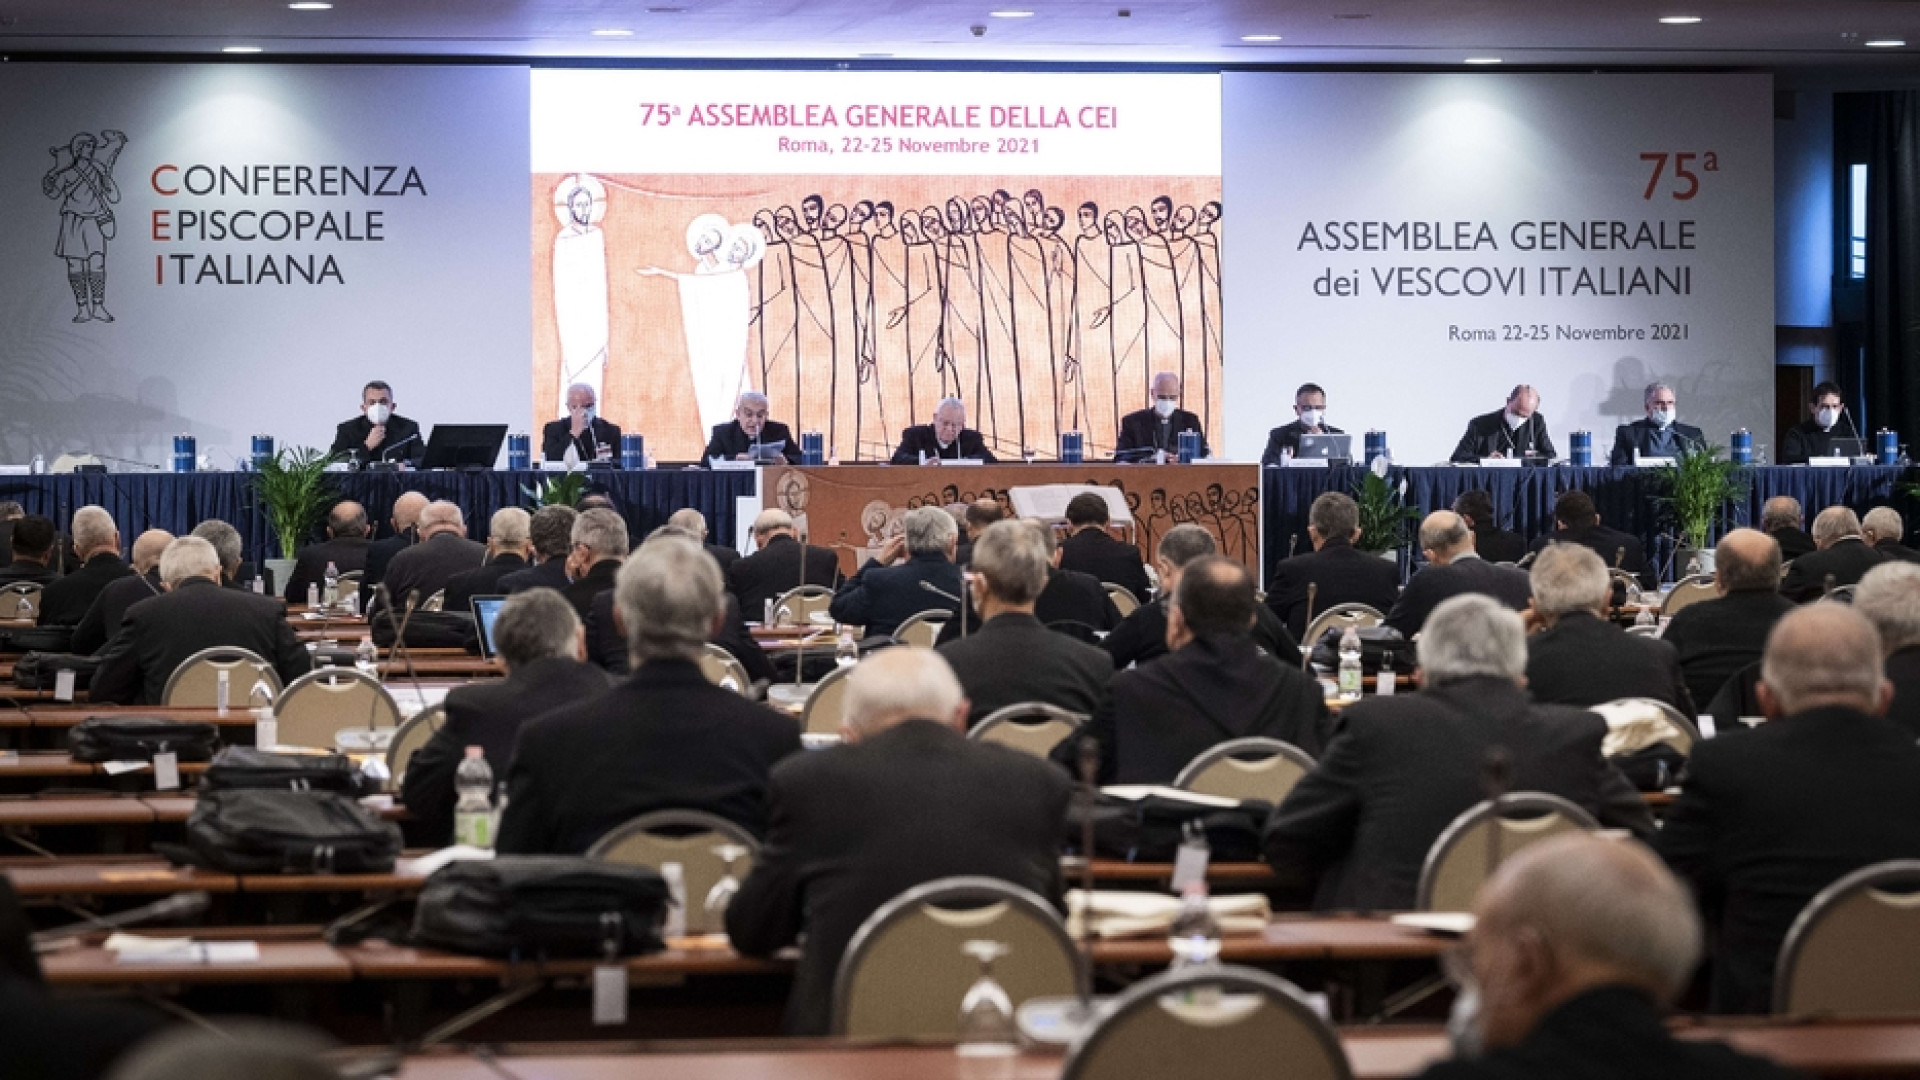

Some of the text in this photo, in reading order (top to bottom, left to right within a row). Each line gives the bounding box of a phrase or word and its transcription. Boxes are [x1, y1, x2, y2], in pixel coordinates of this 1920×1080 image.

[688, 104, 838, 126] ASSEMBLEA
[845, 105, 980, 127] GENERALE
[991, 105, 1071, 128] DELLA
[1079, 107, 1116, 128] CEI
[779, 136, 1038, 154] Roma, 22-25 Novembre 2021
[152, 165, 427, 195] CONFERENZA
[153, 210, 384, 241] EPISCOPALE
[1297, 222, 1694, 251] ASSEMBLEA GENERALE
[158, 255, 344, 284] ITALIANA
[1314, 267, 1690, 296] dei VESCOVI ITALIANI
[1449, 323, 1688, 341] Roma 22-25 Novembre 2021
